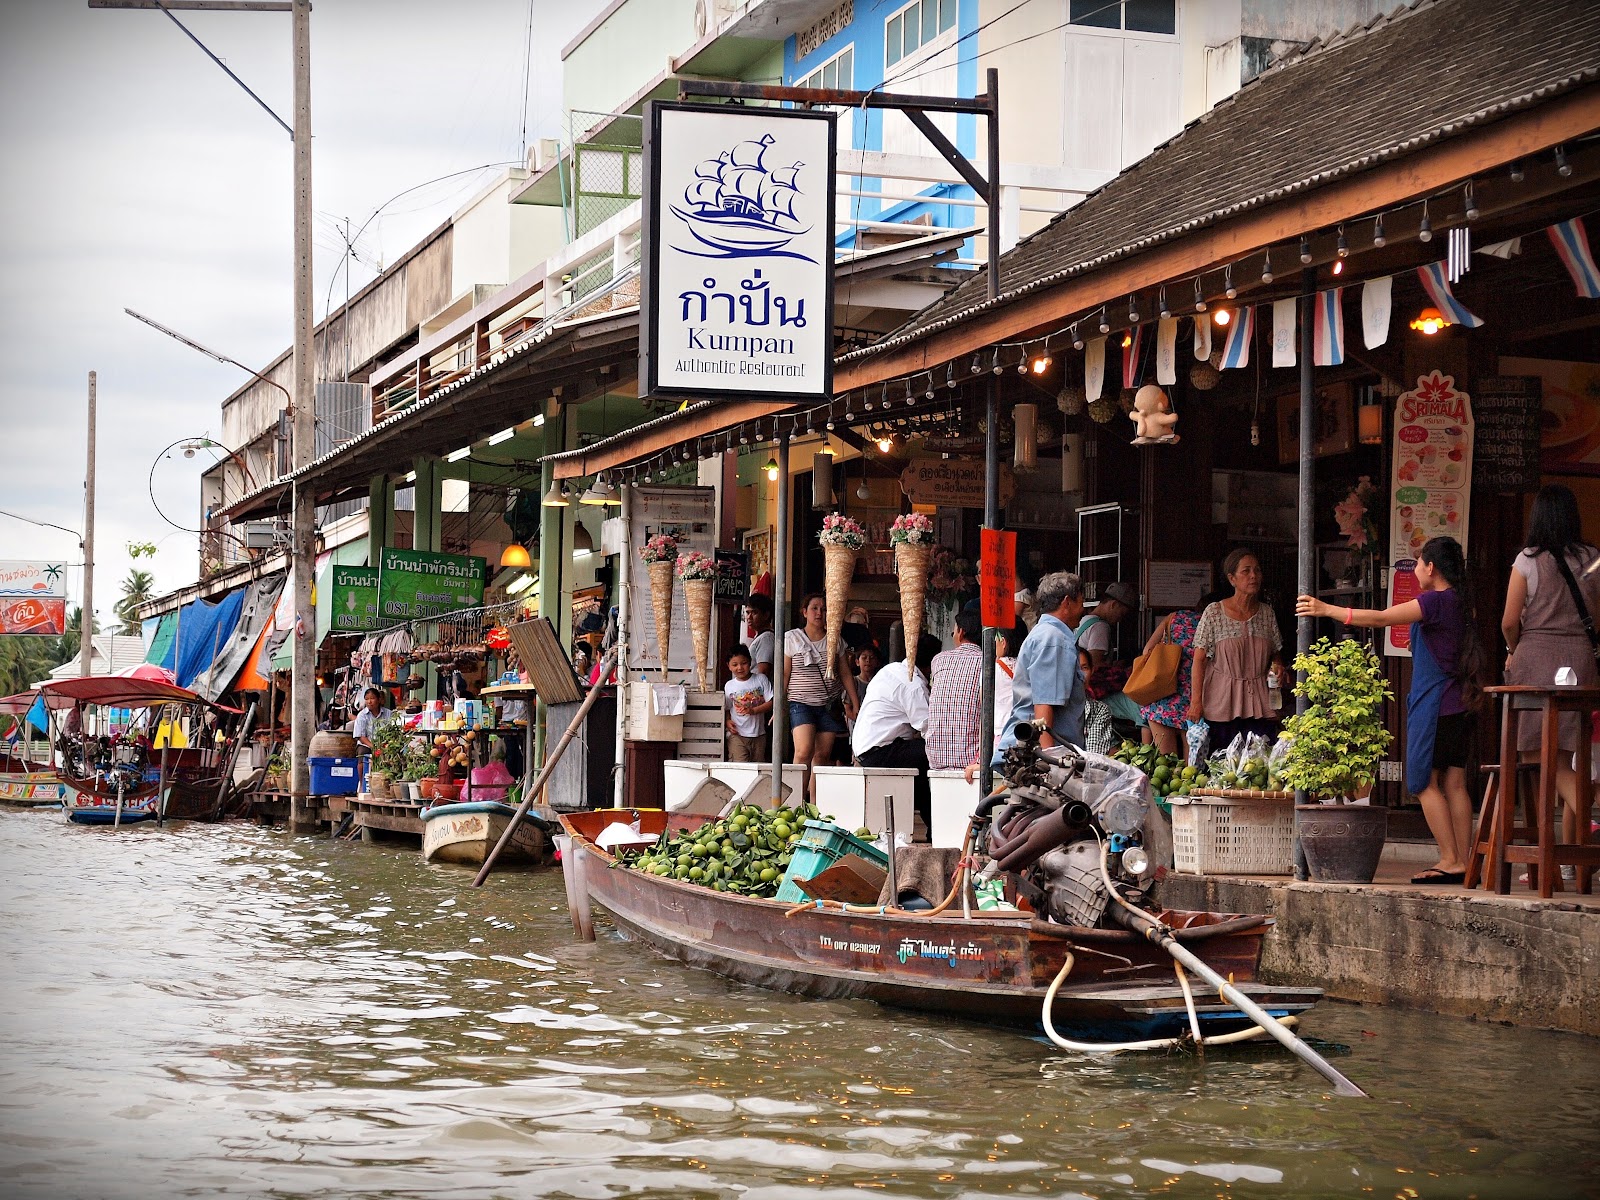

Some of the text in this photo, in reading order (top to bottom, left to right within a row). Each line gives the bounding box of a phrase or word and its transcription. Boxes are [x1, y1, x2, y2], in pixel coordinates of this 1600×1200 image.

[678, 268, 807, 328] กำปั่น
[687, 327, 795, 358] Kumpan
[675, 358, 806, 377] Authentic Restaurant
[1399, 397, 1469, 425] SRIMALA
[337, 570, 379, 586] บ้านน่า
